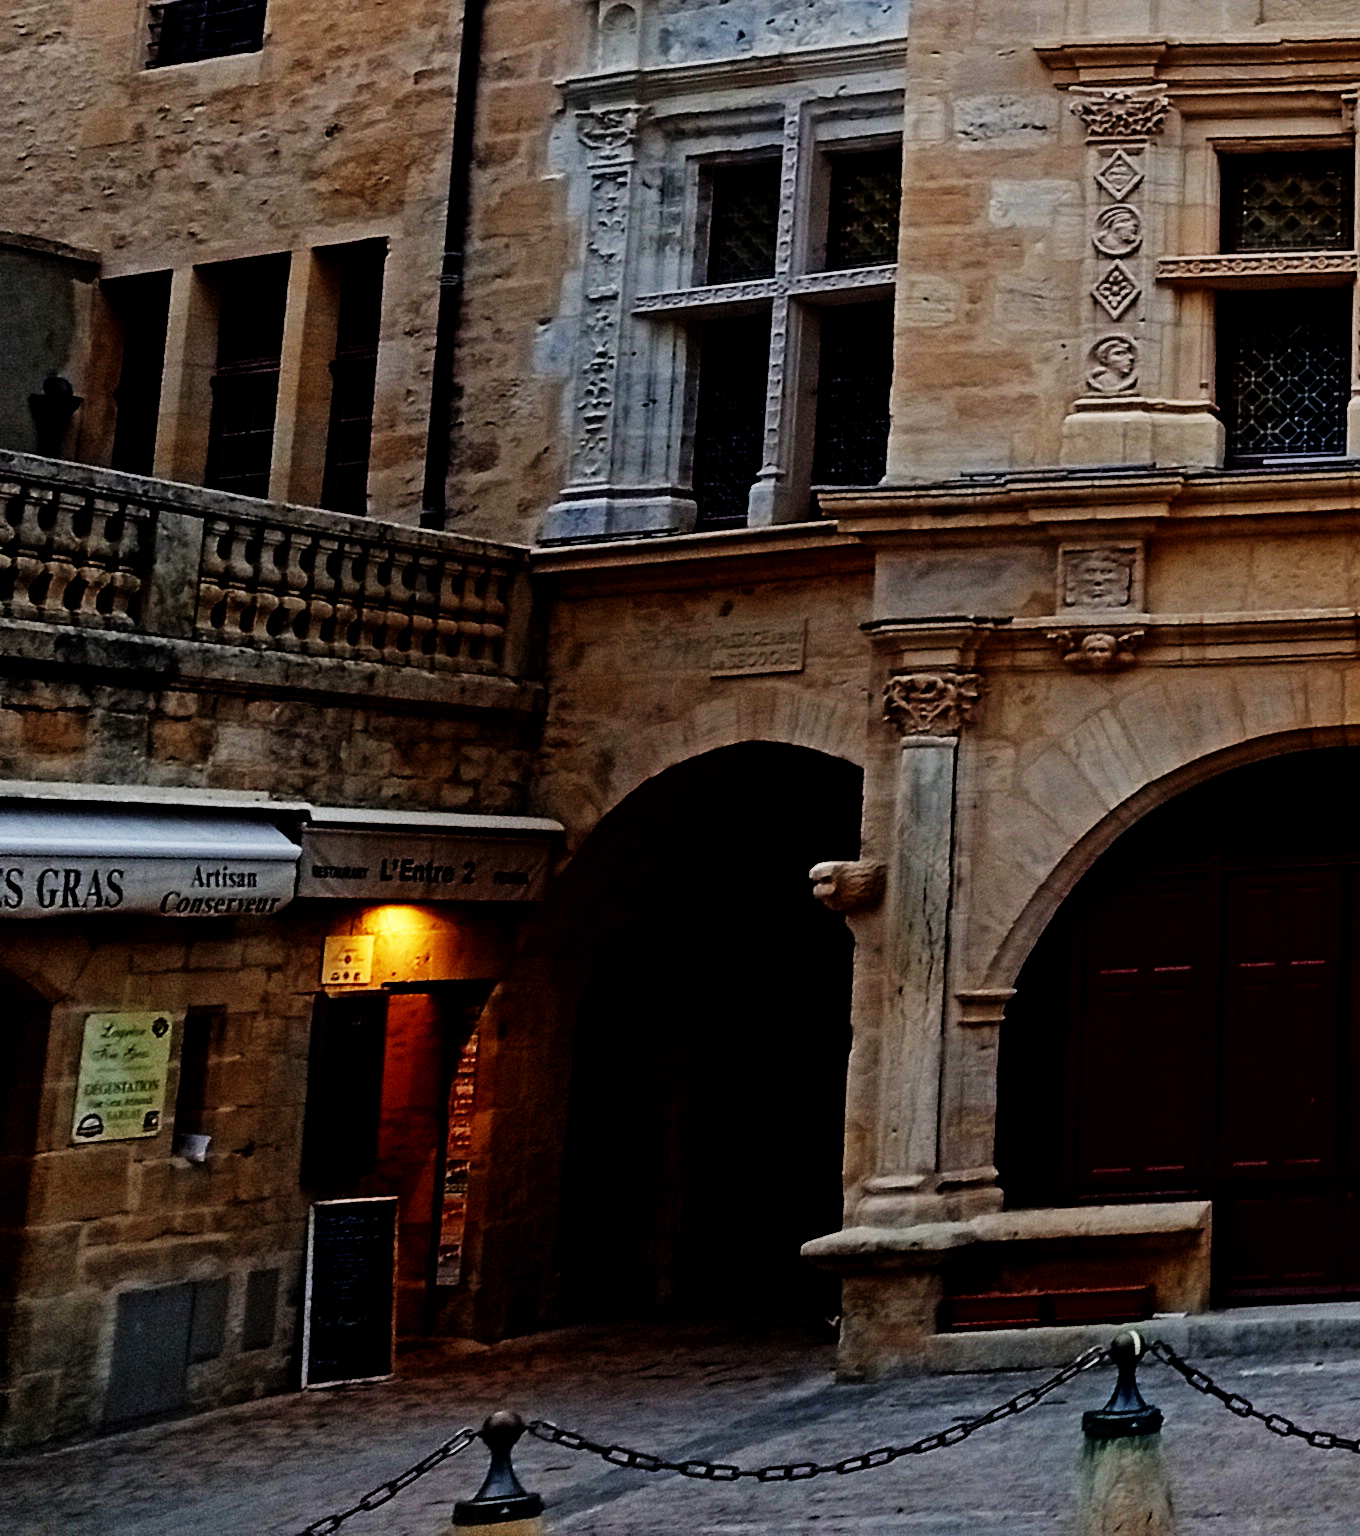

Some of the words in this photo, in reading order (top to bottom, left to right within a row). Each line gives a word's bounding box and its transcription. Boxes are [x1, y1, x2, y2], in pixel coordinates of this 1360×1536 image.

[192, 865, 258, 889] Artisan
[380, 858, 455, 884] L'Entre
[461, 860, 476, 885] 2
[36, 867, 124, 910] GRAS
[160, 890, 281, 915] Conserveur
